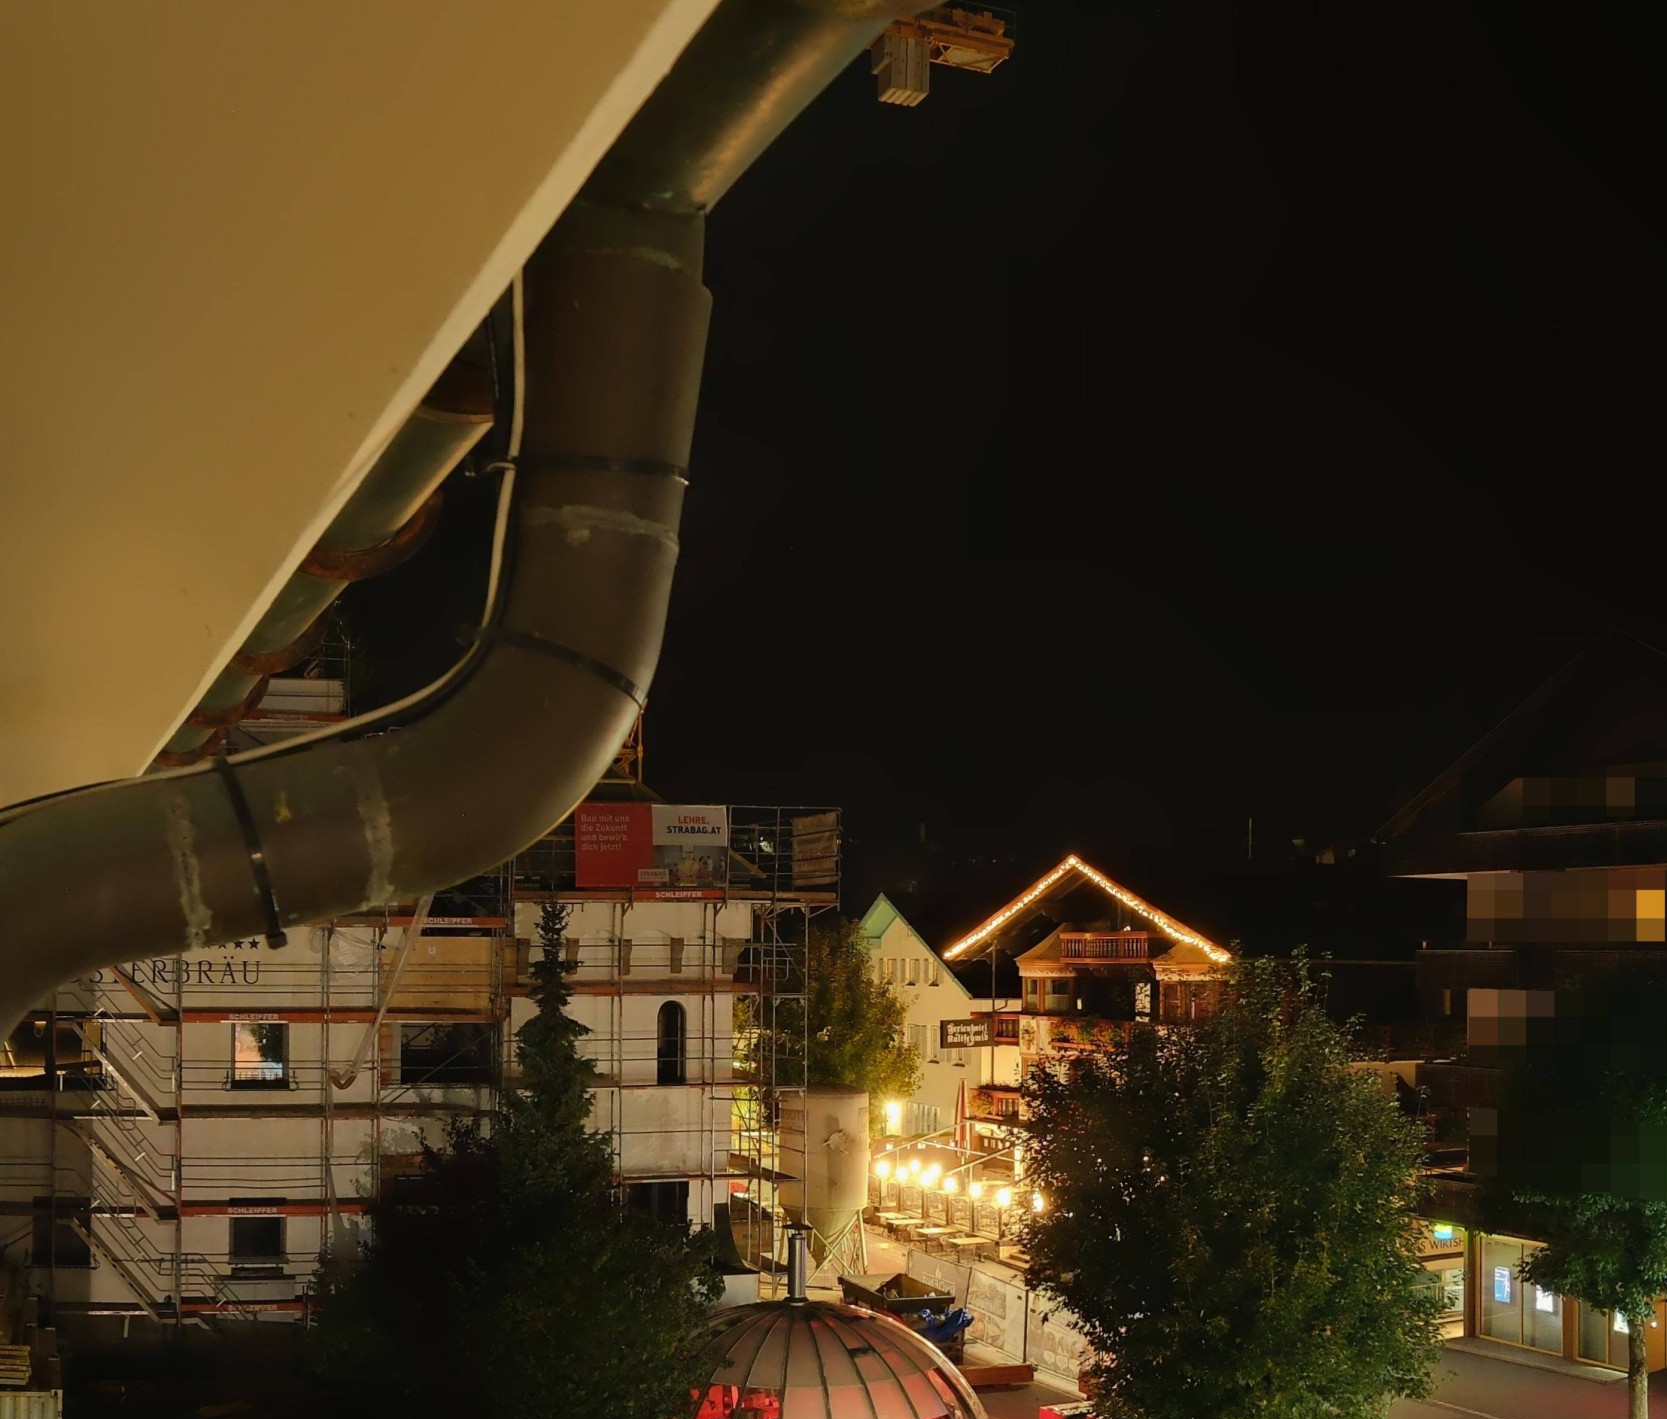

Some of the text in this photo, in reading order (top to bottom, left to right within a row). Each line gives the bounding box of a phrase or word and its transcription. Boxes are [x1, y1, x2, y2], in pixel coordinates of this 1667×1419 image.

[580, 814, 596, 823] Bau
[599, 814, 612, 823] mit
[677, 816, 710, 825] LEHRE.
[581, 824, 628, 832] die Zukunft
[666, 825, 721, 835] STRABAG.AT
[581, 833, 628, 842] und bewirb
[581, 843, 598, 851] dich
